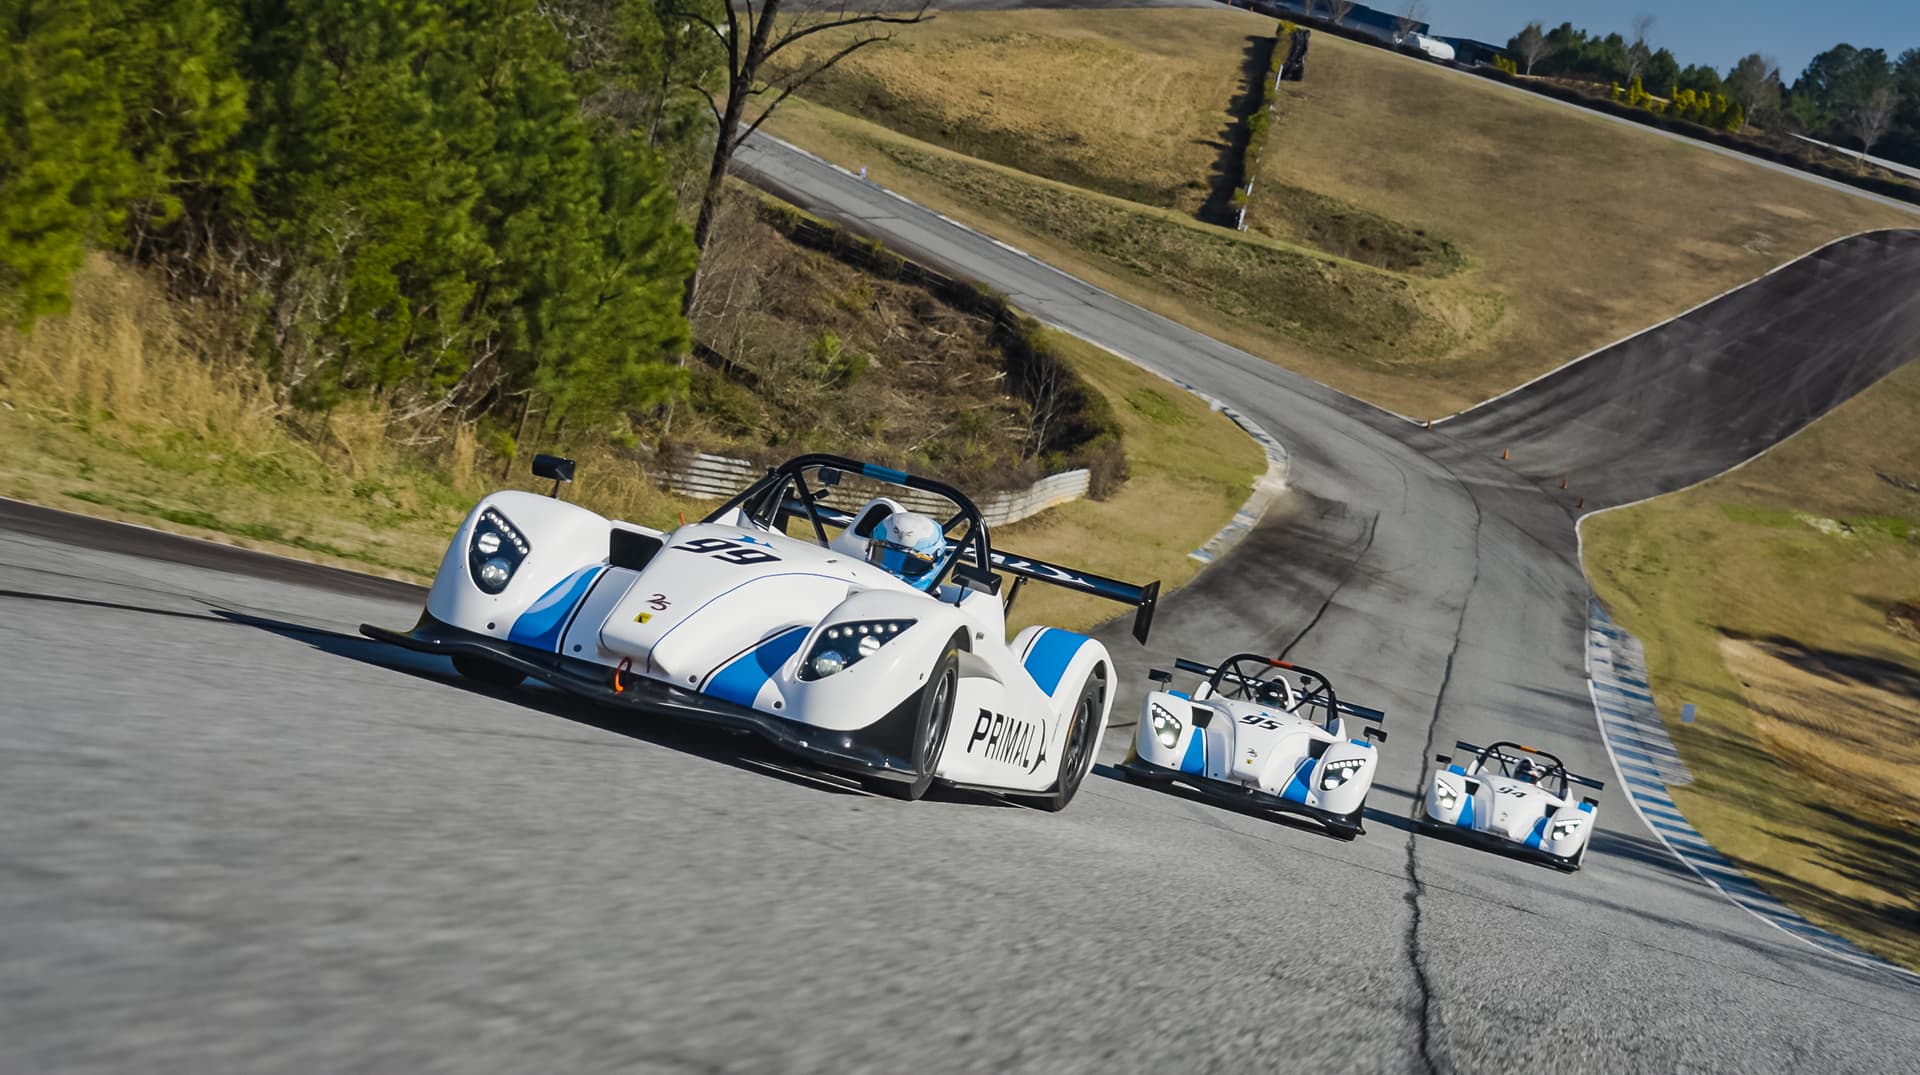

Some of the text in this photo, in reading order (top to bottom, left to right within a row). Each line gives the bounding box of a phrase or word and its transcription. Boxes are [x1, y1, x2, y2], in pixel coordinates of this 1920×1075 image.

[671, 538, 782, 565] 99
[648, 593, 671, 611] 25
[1239, 715, 1284, 731] 95
[967, 708, 1036, 768] PRIMAL
[1497, 786, 1527, 798] 94
